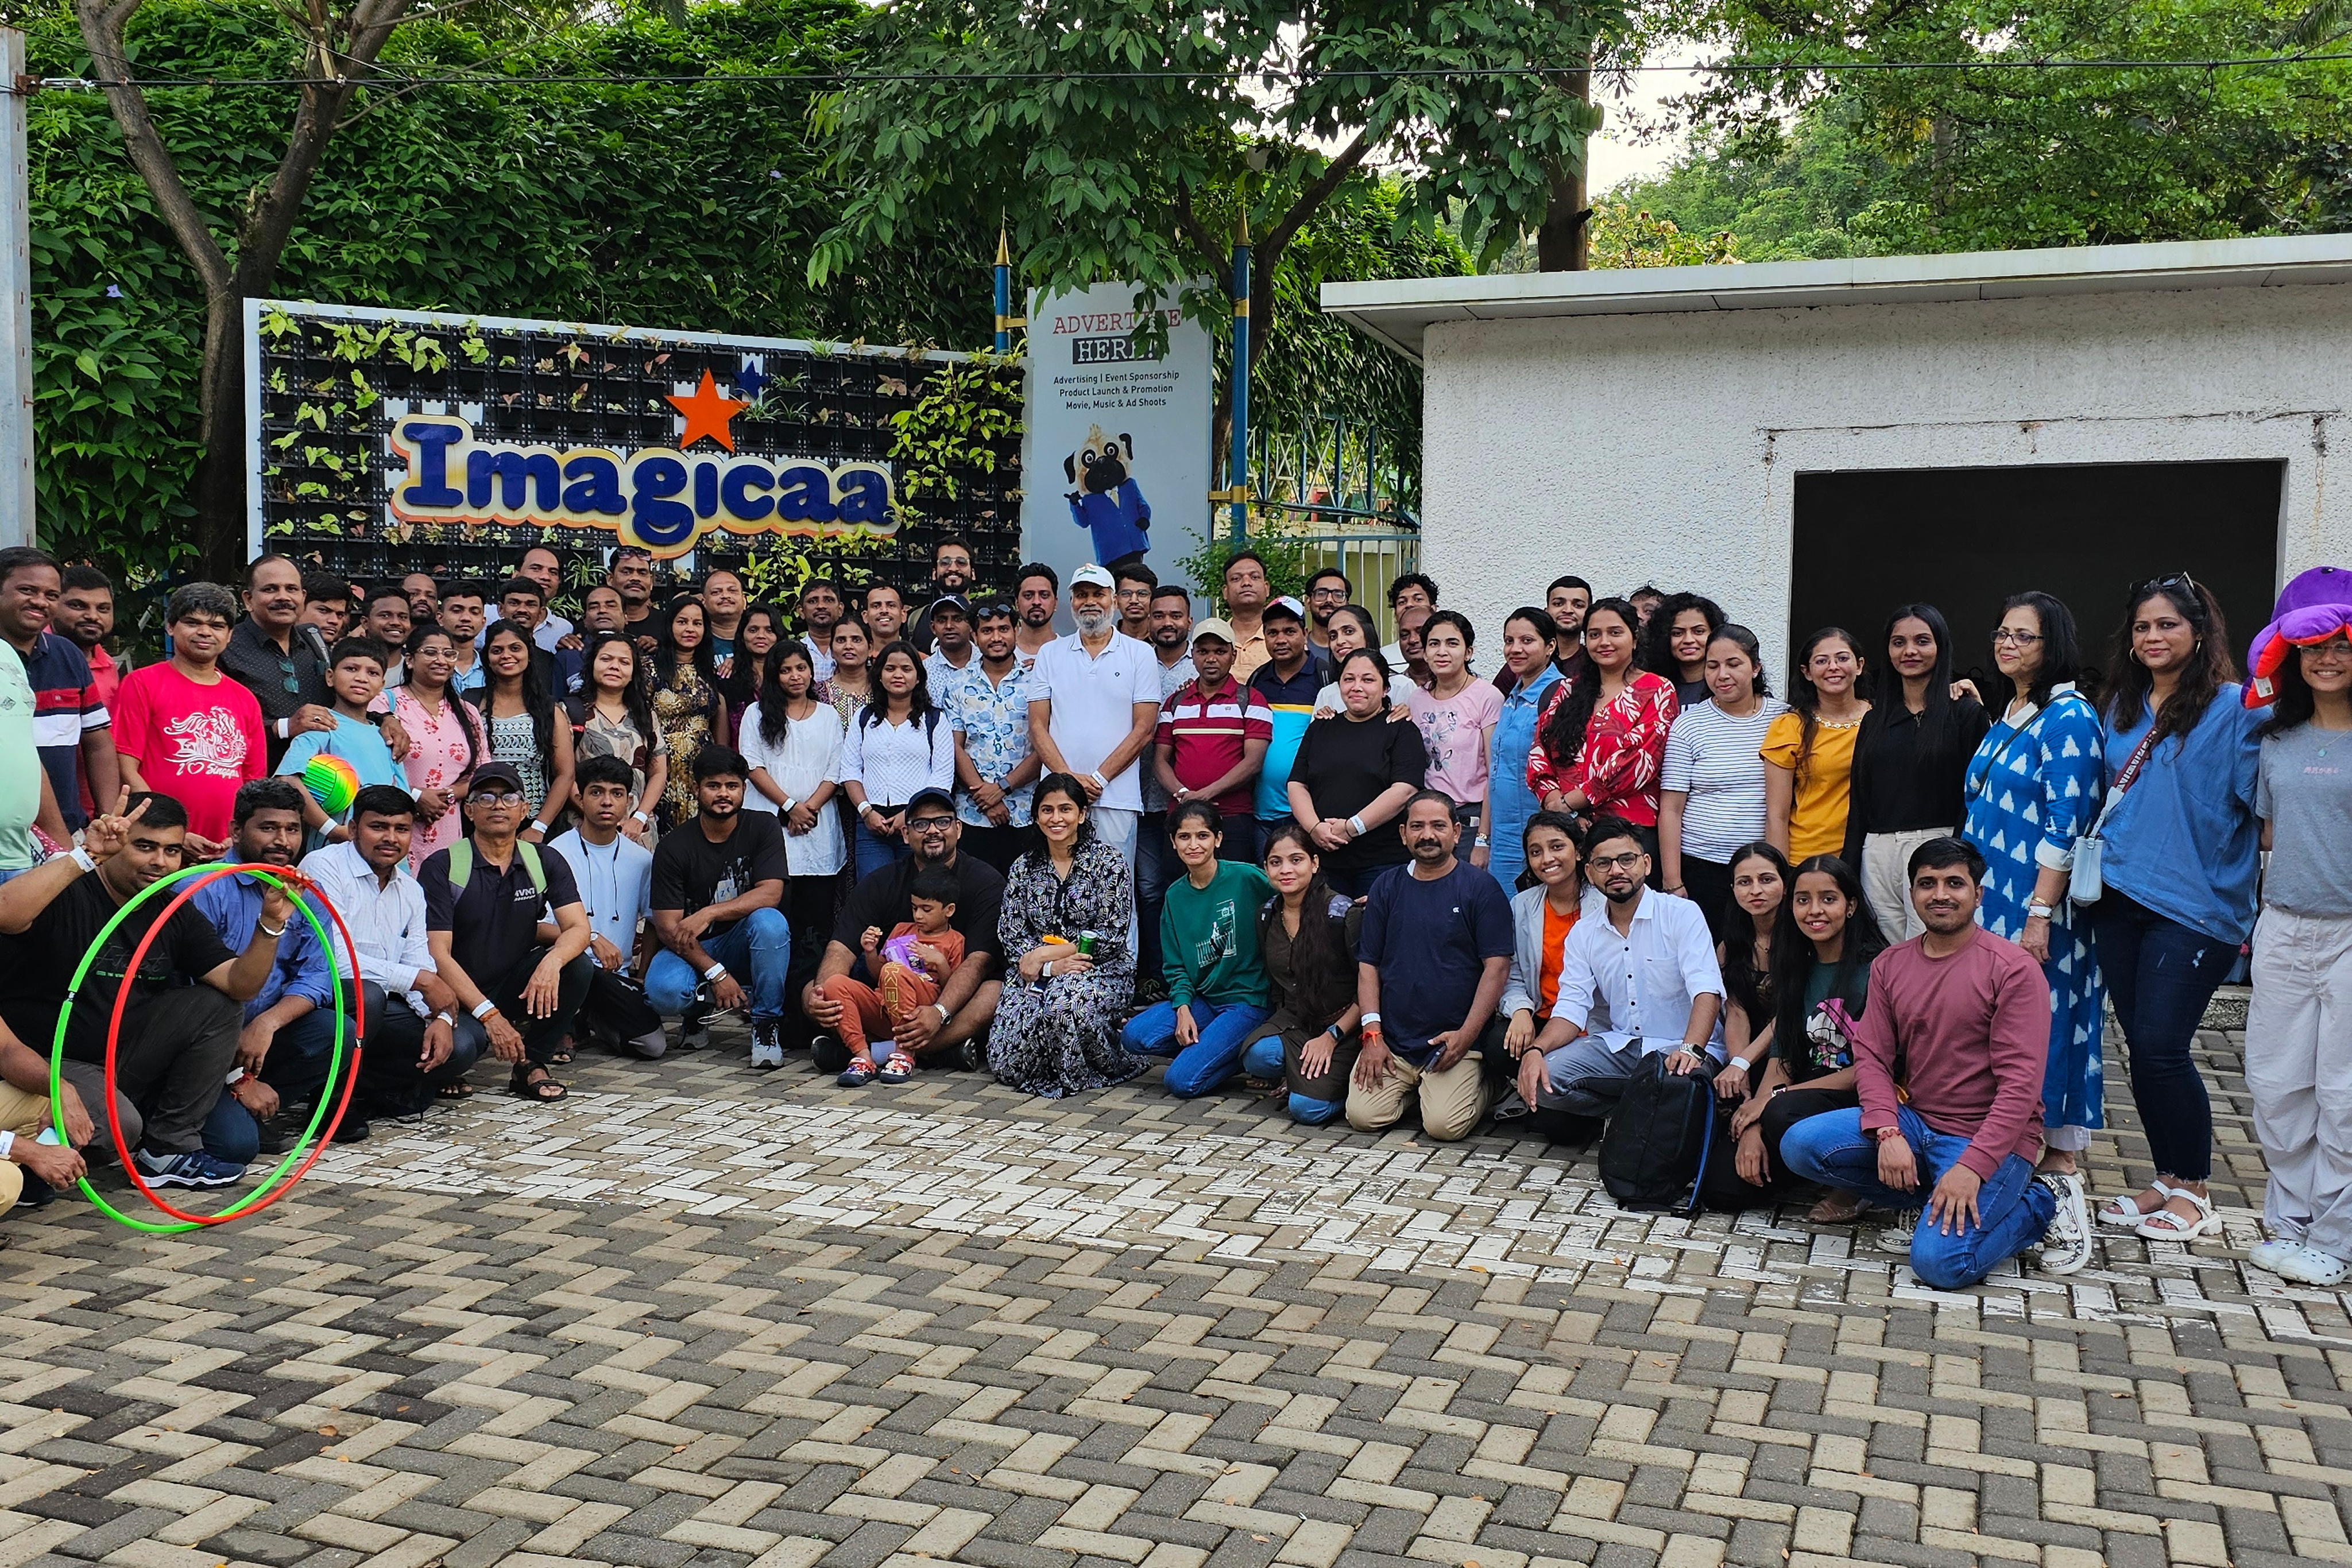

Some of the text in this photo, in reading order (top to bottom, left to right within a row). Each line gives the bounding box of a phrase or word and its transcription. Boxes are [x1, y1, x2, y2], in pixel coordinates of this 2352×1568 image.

[1053, 309, 1181, 334] ADVERTE
[1053, 374, 1098, 385] Advertising
[1105, 373, 1127, 382] Event
[1129, 370, 1179, 382] Sponsorship
[1059, 384, 1173, 397] Product Launch & Promotion
[1066, 397, 1166, 410] Movie, Music & Ad Shoots
[402, 422, 894, 545] Imagicaa
